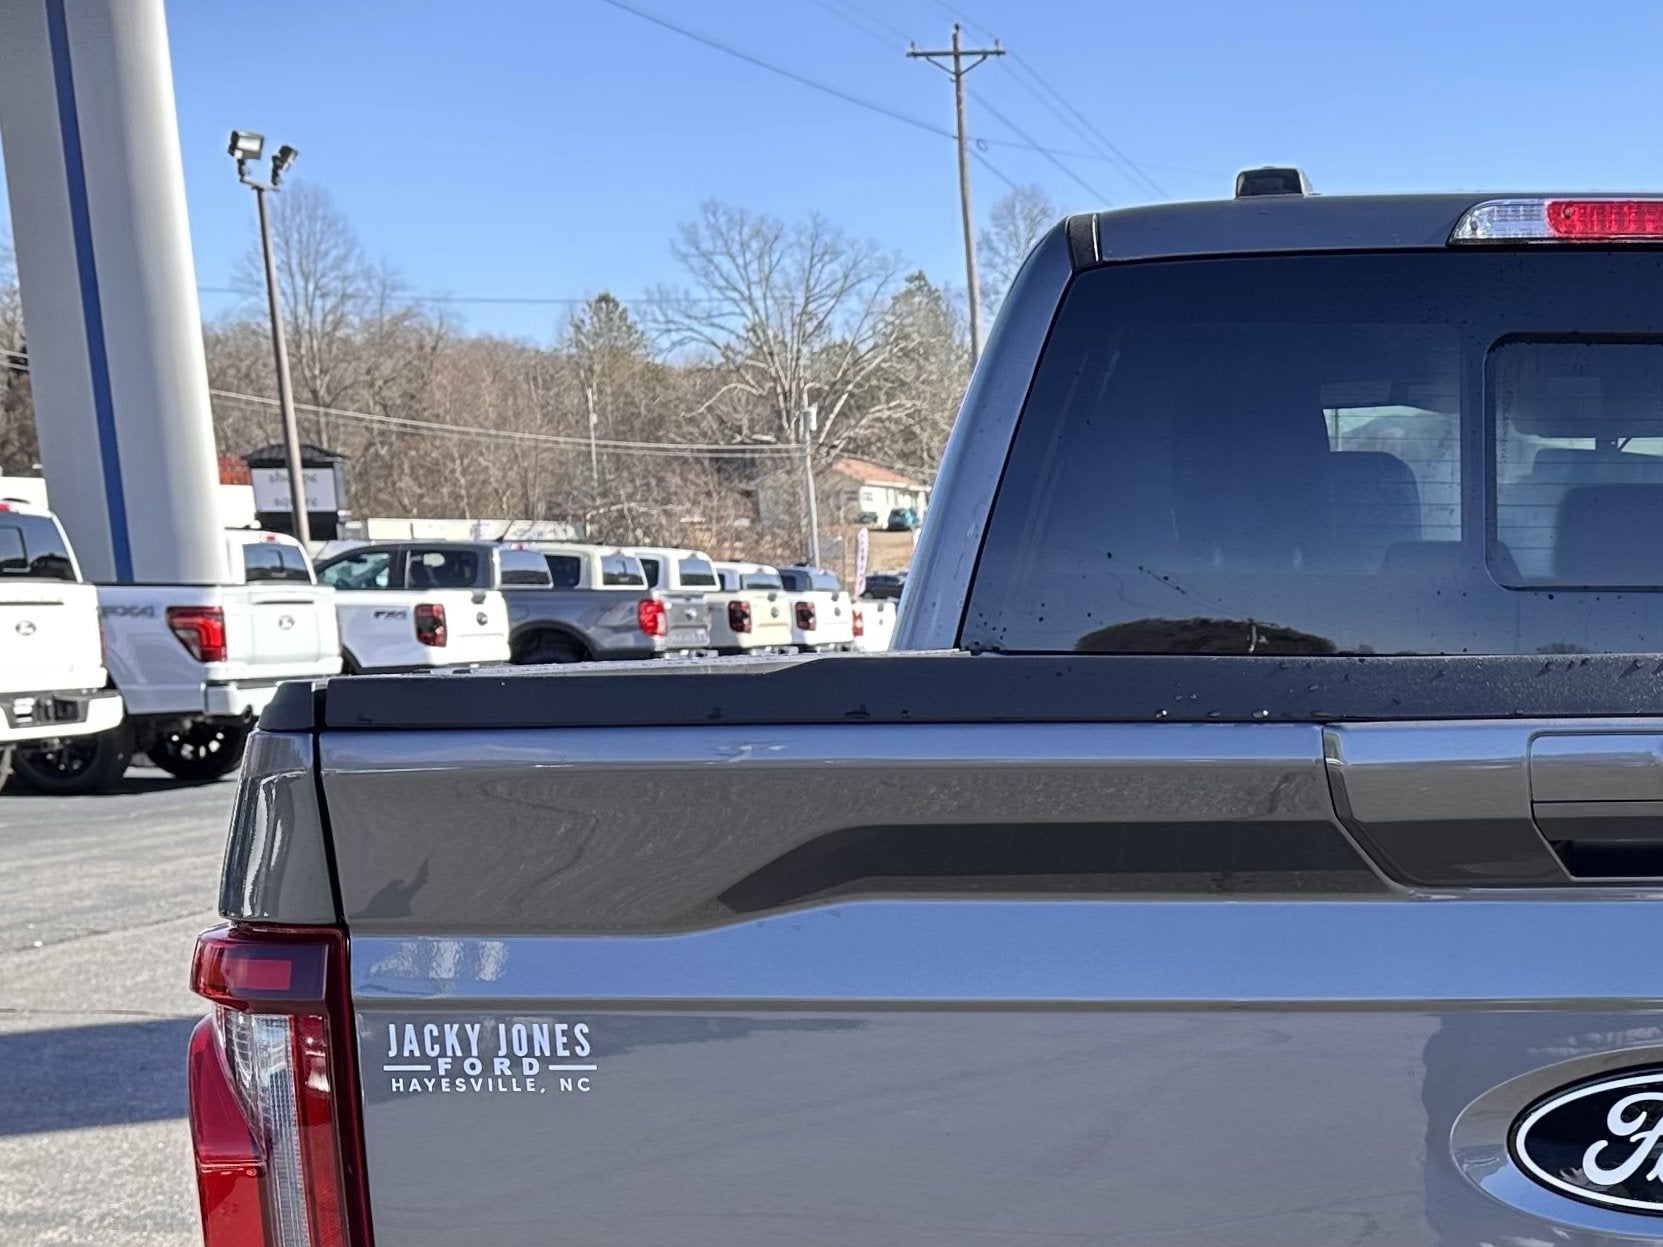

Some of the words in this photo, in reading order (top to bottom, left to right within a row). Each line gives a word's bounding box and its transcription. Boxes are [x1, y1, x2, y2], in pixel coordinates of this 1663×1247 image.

[388, 1023, 481, 1057] JACKY
[498, 1023, 592, 1057] JONES
[438, 1057, 540, 1075] FORD
[391, 1078, 546, 1094] HAYESVILLE,
[559, 1078, 591, 1092] NC
